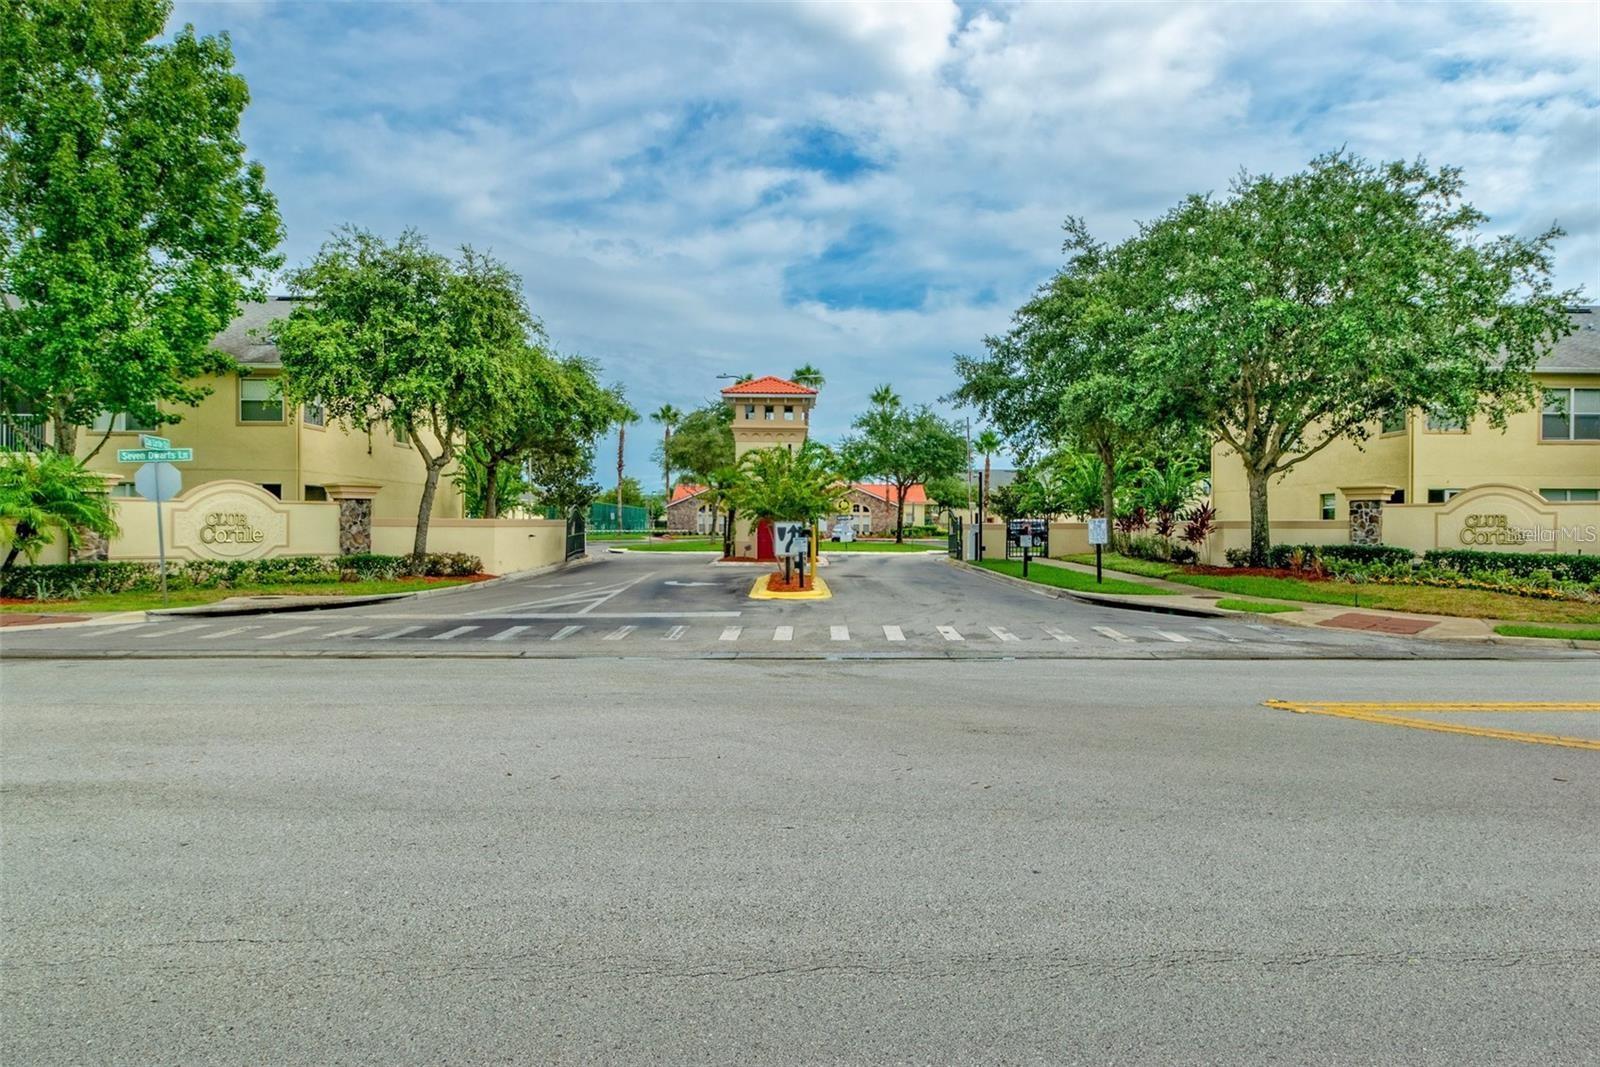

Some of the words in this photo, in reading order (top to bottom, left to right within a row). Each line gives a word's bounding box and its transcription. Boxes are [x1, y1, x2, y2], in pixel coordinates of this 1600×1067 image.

[120, 451, 146, 460] Seven
[178, 450, 189, 459] Ln
[205, 512, 248, 527] CLUB
[1464, 514, 1508, 528] CLUB
[199, 525, 264, 544] Cortile
